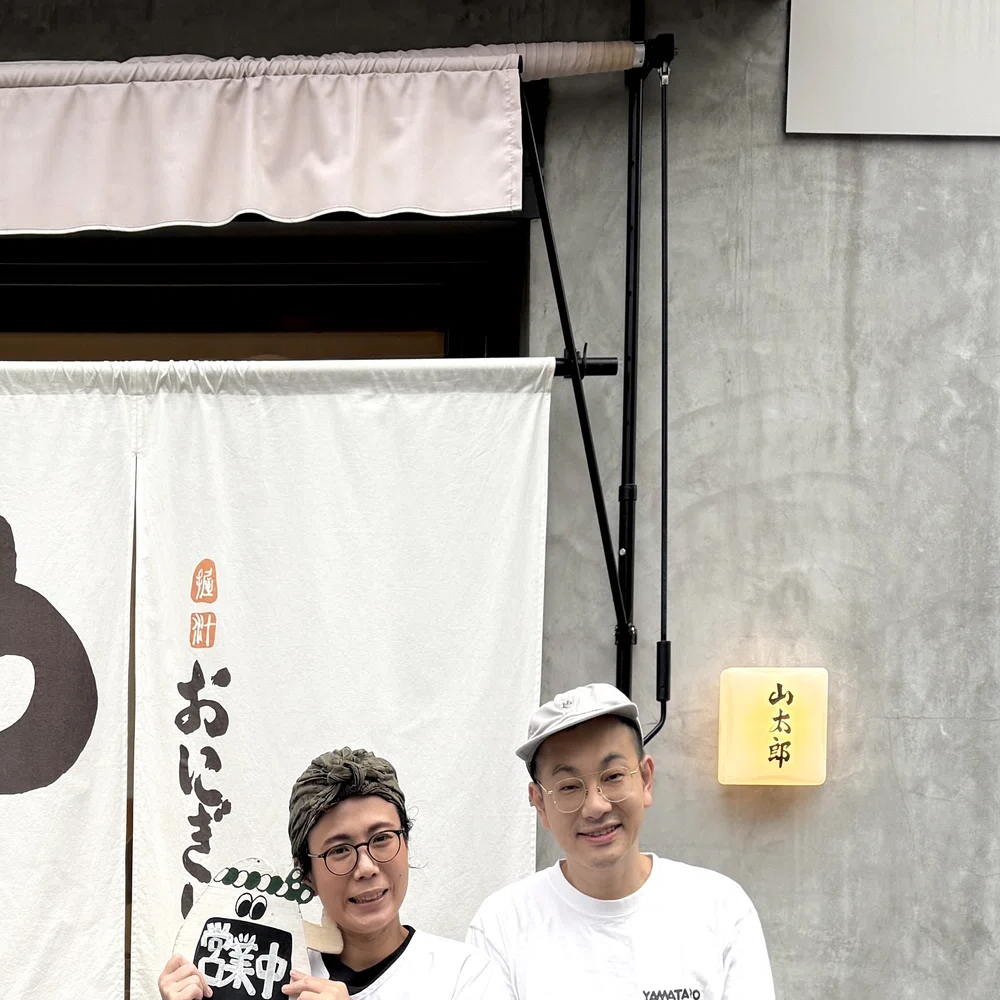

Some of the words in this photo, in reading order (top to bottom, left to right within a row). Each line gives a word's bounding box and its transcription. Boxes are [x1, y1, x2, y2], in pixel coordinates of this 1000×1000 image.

[768, 683, 794, 768] 山太郎
[198, 922, 288, 1000] 営業中
